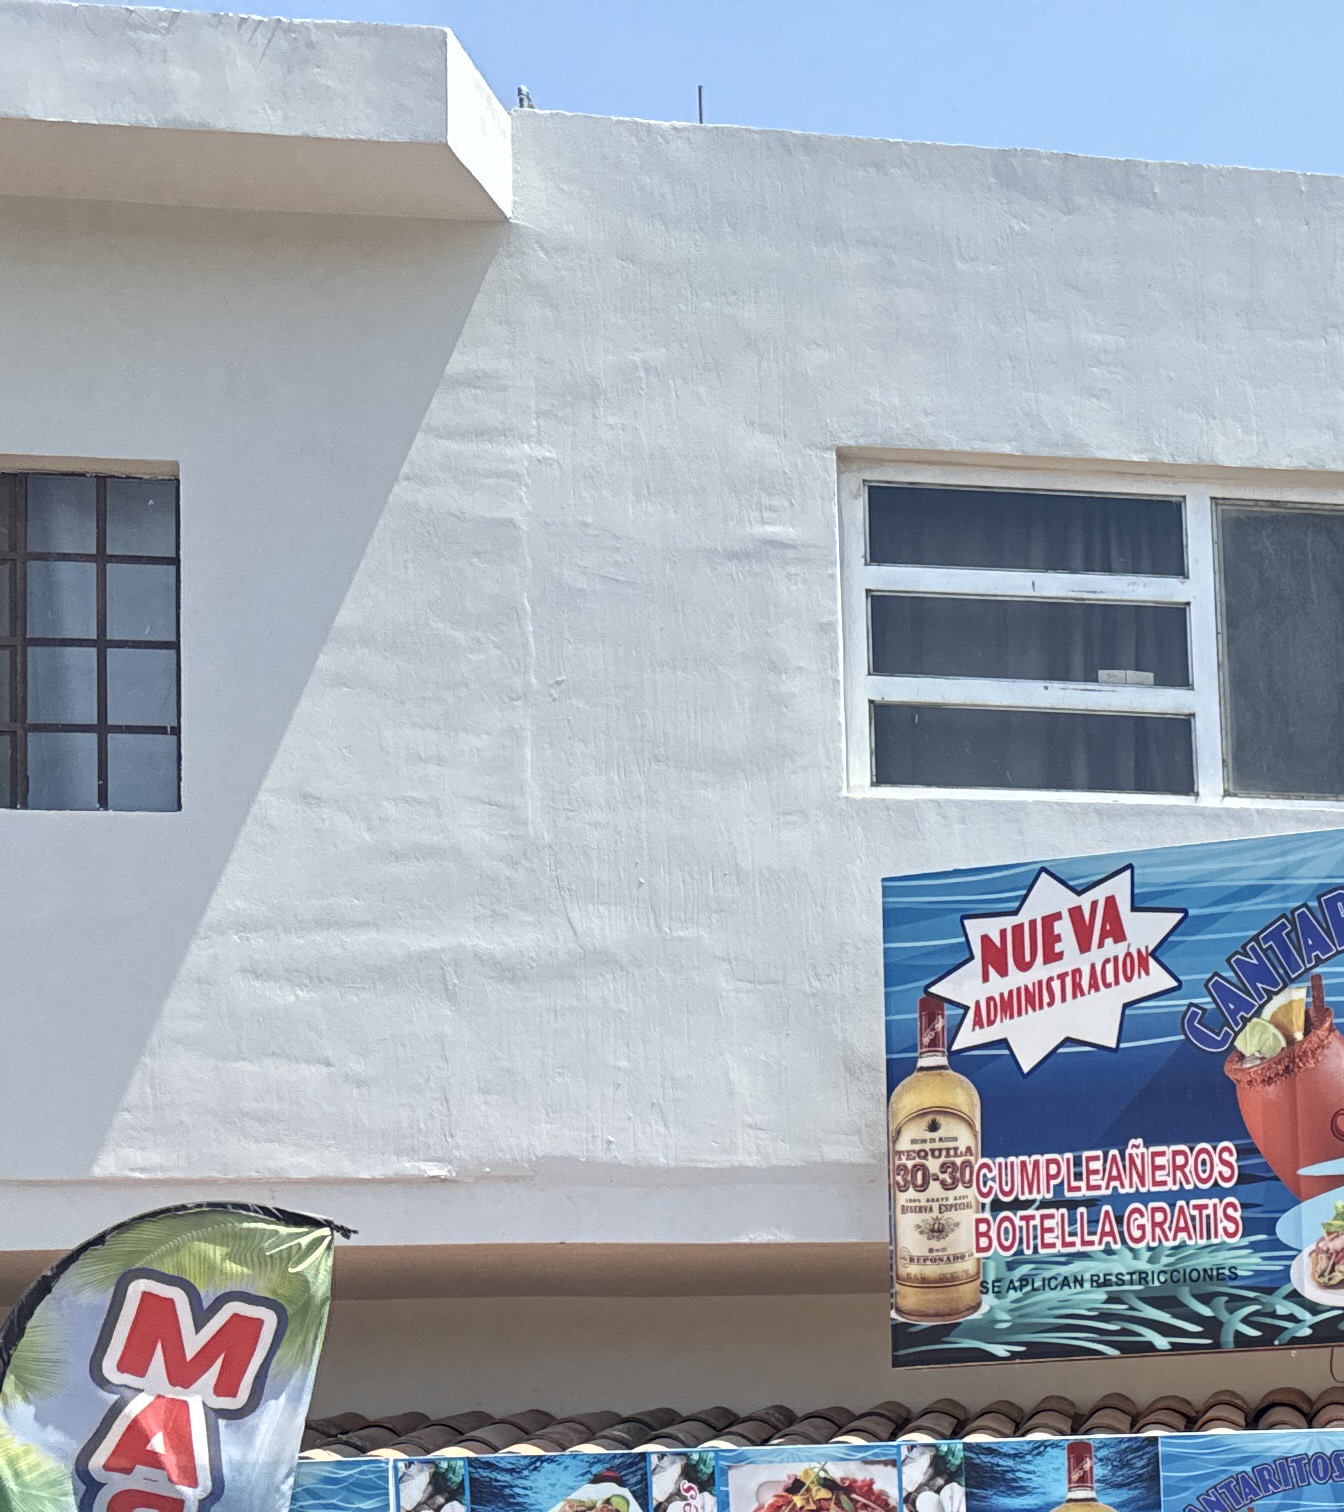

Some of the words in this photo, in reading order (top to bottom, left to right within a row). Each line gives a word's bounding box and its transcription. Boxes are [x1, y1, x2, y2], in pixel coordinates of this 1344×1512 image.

[980, 894, 1127, 983] NUEVA
[971, 943, 1151, 1032] ADMINISTRACIÓN
[895, 1145, 974, 1161] TEQUILA
[896, 1159, 974, 1193] 30-30
[976, 1141, 1237, 1202] CUMPLEAÑEROS
[975, 1207, 1122, 1256] BOTELLA
[1126, 1199, 1242, 1247] GRATIS
[979, 1275, 1005, 1295] SE
[1008, 1271, 1084, 1293] APLICAN
[1090, 1264, 1239, 1289] RESTRICCIONES
